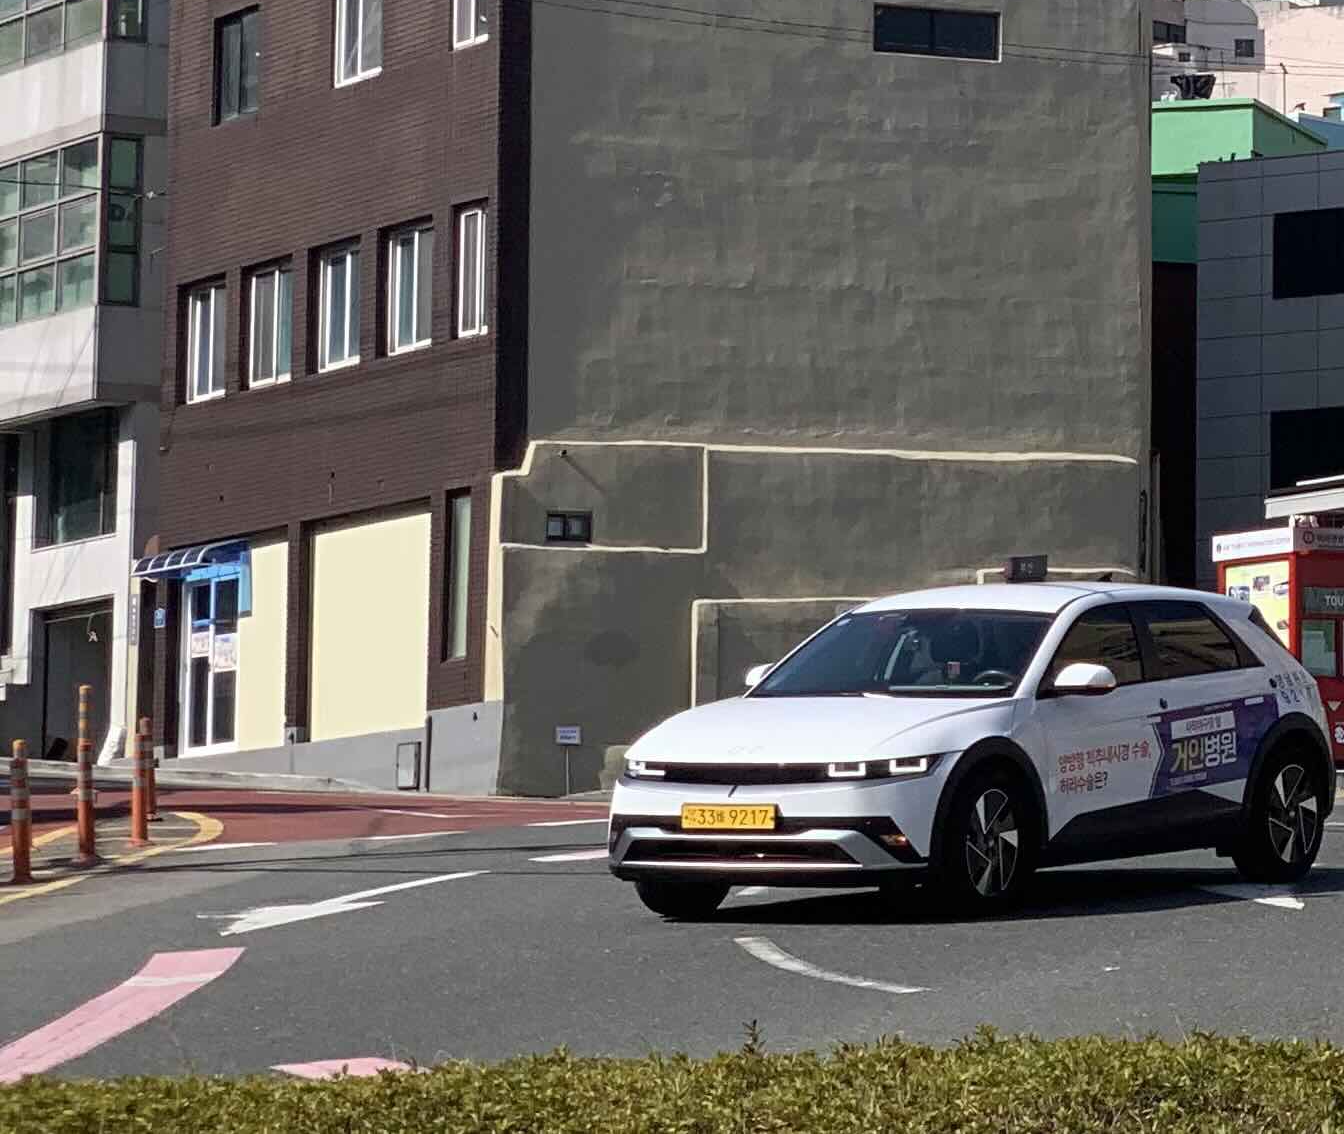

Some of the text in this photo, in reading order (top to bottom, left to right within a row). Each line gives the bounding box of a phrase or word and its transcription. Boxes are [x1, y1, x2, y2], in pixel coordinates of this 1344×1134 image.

[1058, 751, 1084, 774] 양방향
[1087, 743, 1129, 767] 척추내시경
[1169, 730, 1237, 773] 거인병원
[1060, 771, 1108, 795] 허리수술은?
[728, 809, 769, 826] 9217
